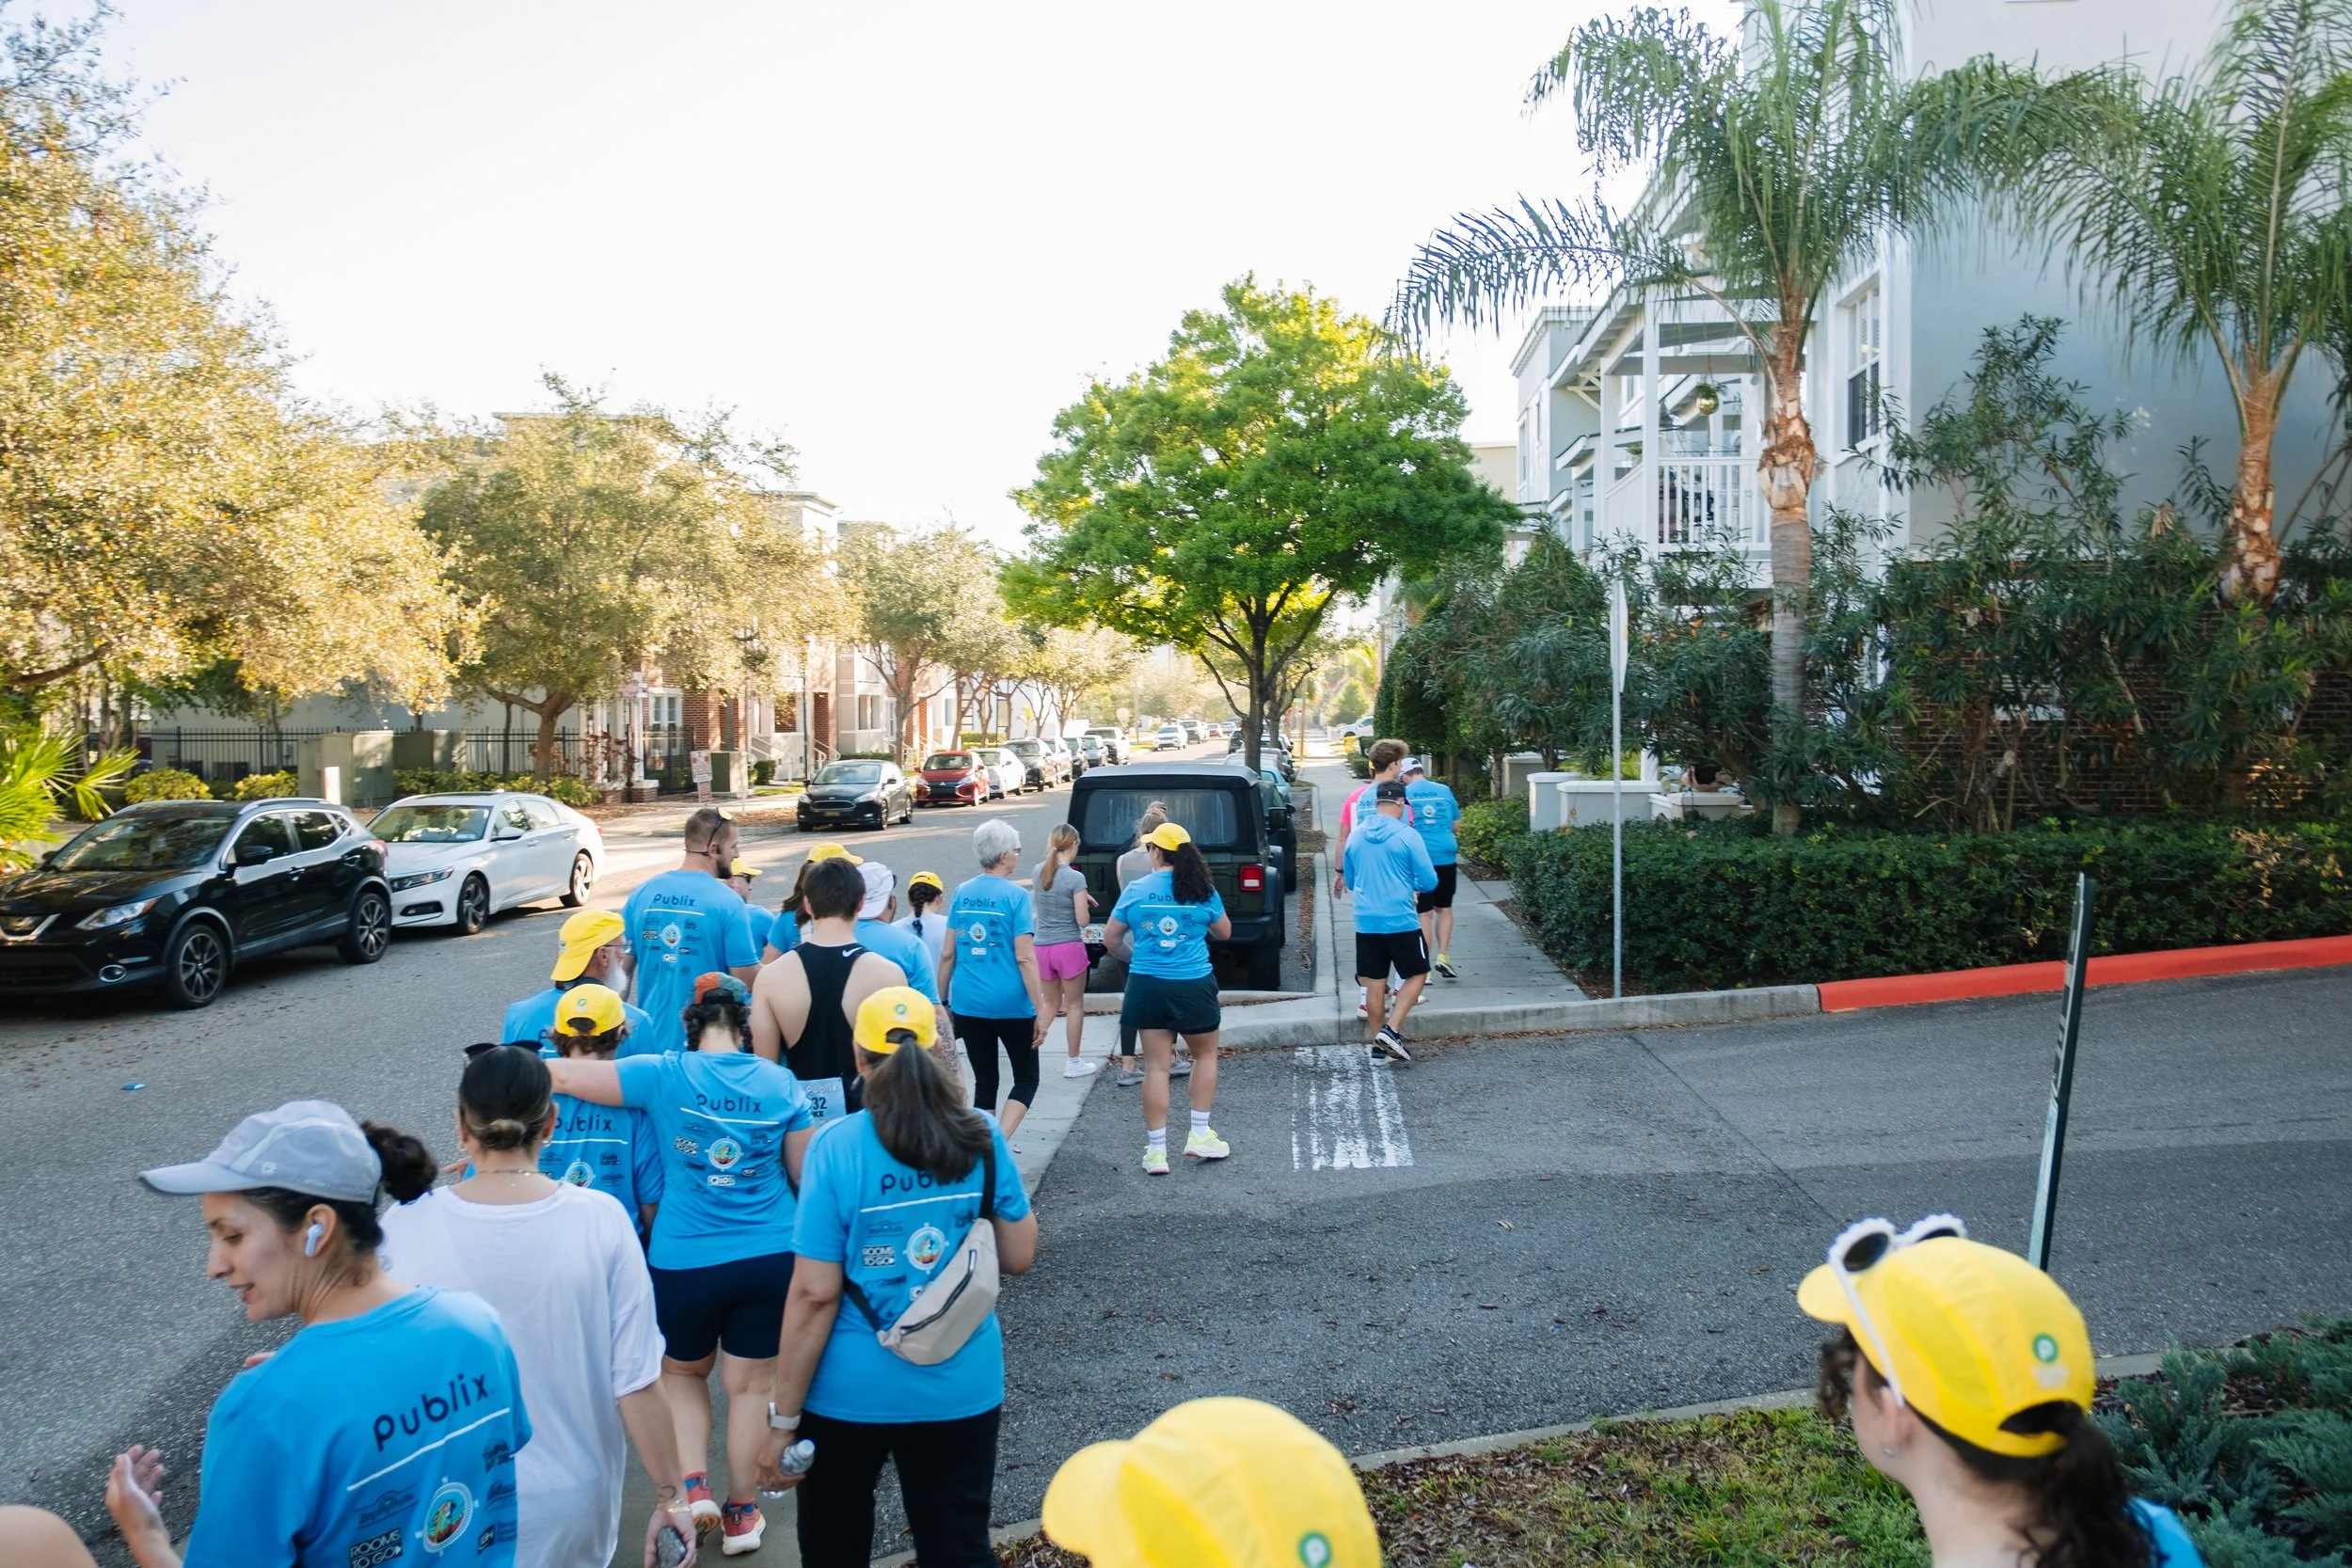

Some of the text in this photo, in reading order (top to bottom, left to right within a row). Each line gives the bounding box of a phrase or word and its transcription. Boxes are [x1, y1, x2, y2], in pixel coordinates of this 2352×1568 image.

[654, 894, 696, 907] Publix
[962, 898, 997, 908] Publix
[1148, 893, 1173, 902] Pub
[696, 1094, 761, 1114] Publix
[811, 1097, 828, 1111] 32
[881, 1172, 933, 1196] Pub
[373, 1372, 489, 1453] Publix
[350, 1529, 401, 1559] ROOMS
[352, 1545, 396, 1568] TO GO
